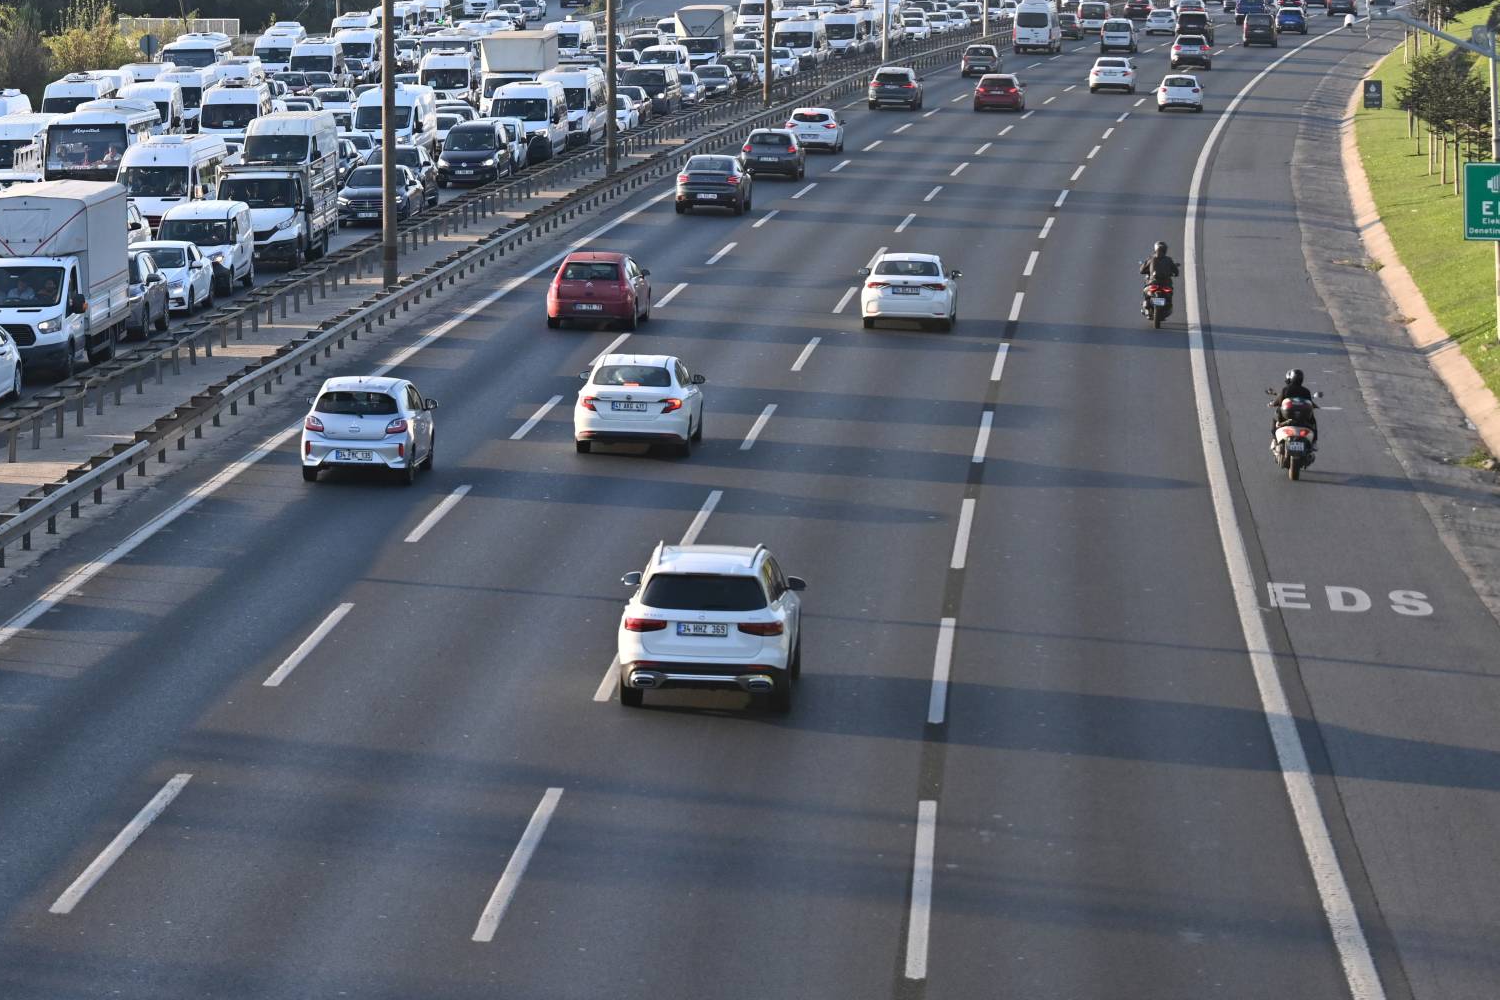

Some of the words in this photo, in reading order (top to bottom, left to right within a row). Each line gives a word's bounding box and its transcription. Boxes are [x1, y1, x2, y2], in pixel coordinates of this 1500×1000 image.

[1482, 201, 1500, 215] E
[1267, 582, 1434, 617] EDS
[683, 624, 691, 633] 34
